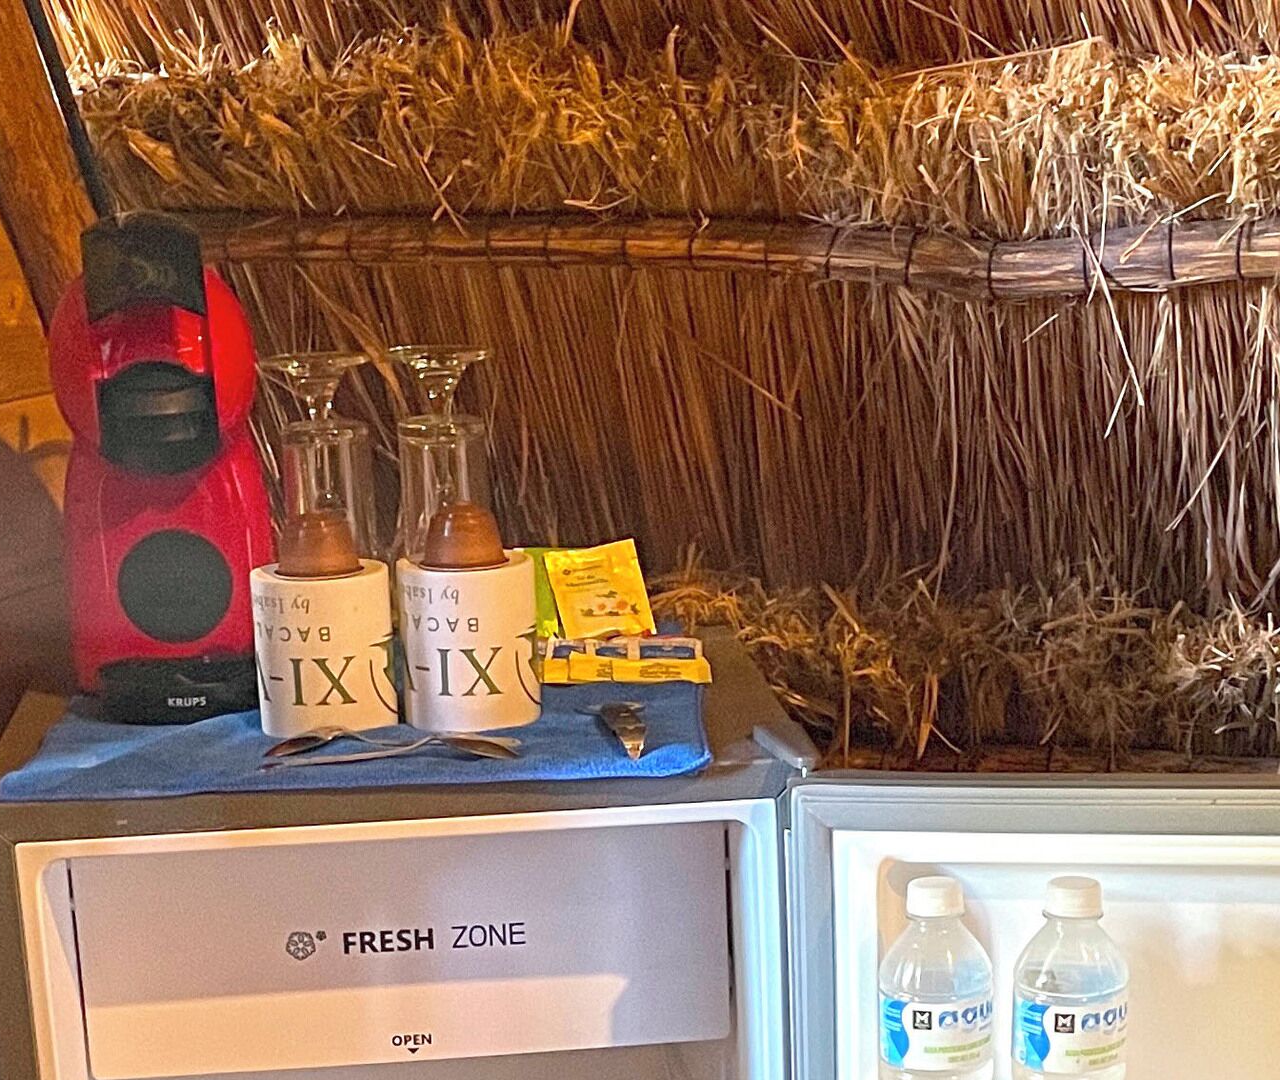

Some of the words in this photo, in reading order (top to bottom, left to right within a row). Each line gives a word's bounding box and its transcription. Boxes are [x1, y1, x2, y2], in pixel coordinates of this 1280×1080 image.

[403, 613, 479, 633] BACA
[167, 696, 207, 708] KRUPS
[342, 927, 435, 955] FRESH
[450, 922, 527, 949] ZONE
[391, 1033, 432, 1047] OPEN
